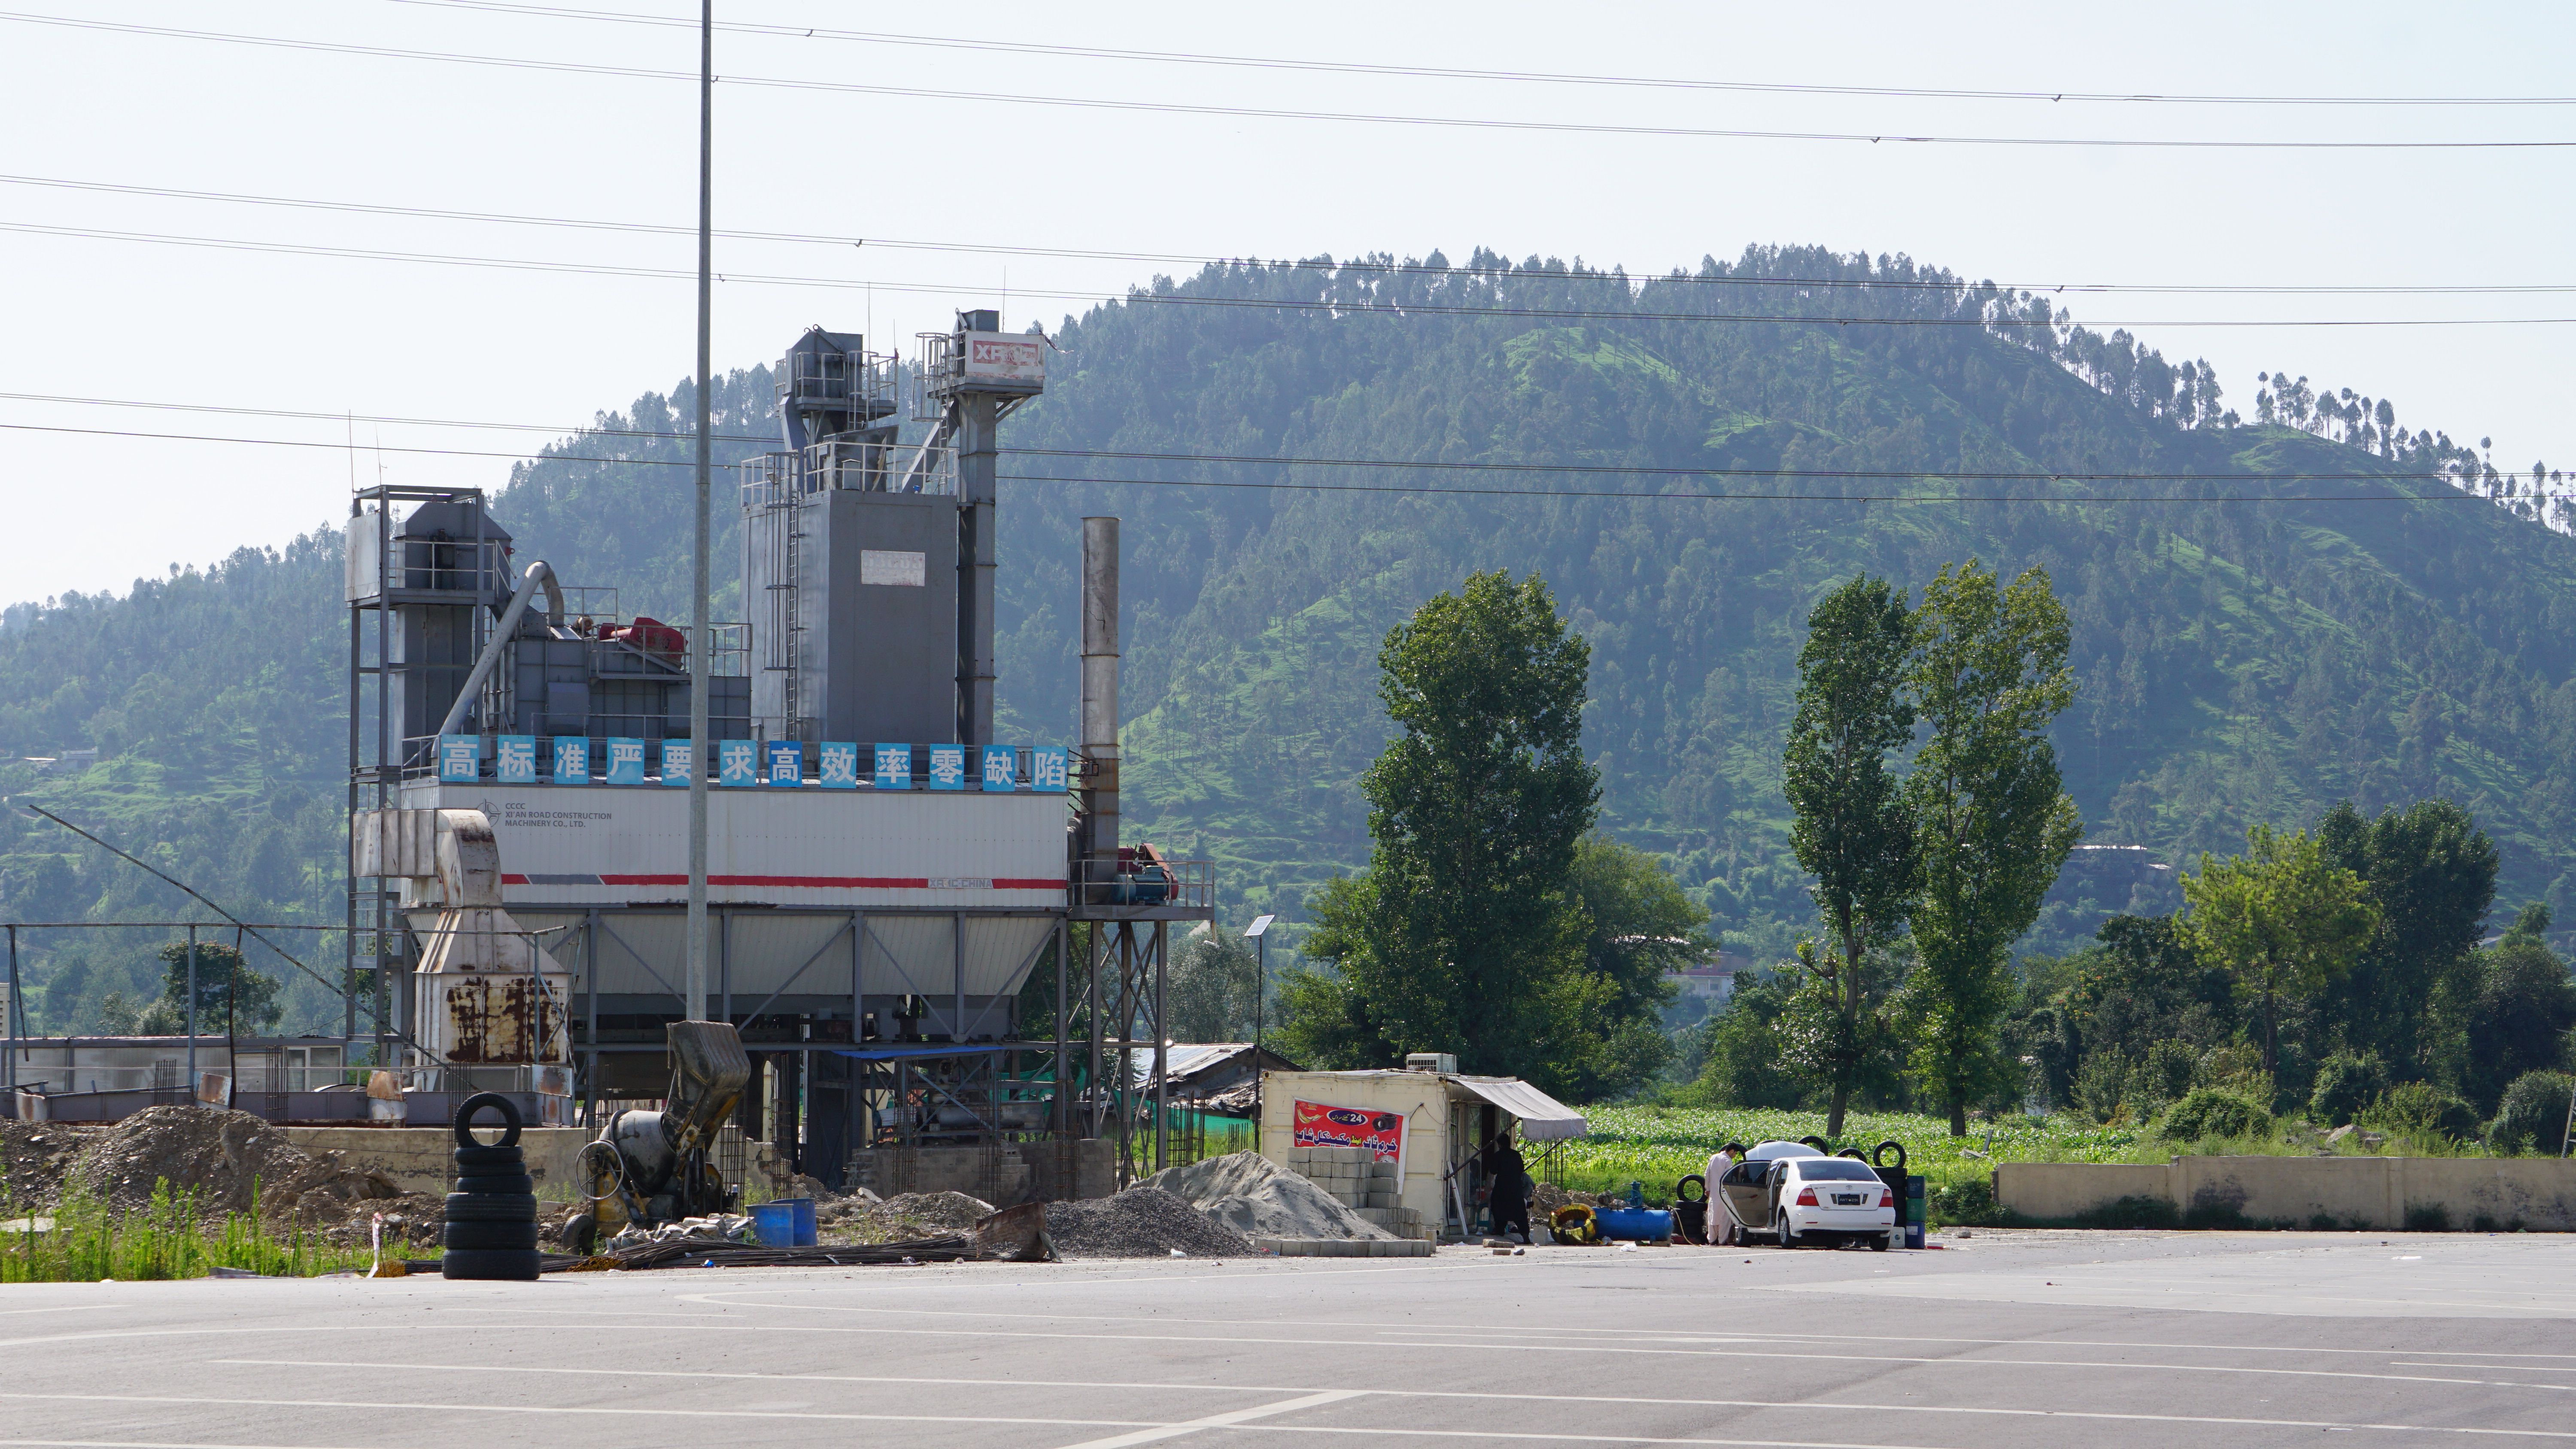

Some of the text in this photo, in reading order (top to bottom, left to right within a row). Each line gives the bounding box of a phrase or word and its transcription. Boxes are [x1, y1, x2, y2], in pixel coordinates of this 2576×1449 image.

[443, 740, 1066, 786] 高标准严要求高效率零缺陷
[1350, 1114, 1362, 1123] 24
[1295, 1128, 1313, 1146] شاپ
[1378, 1138, 1398, 1154] خرم
